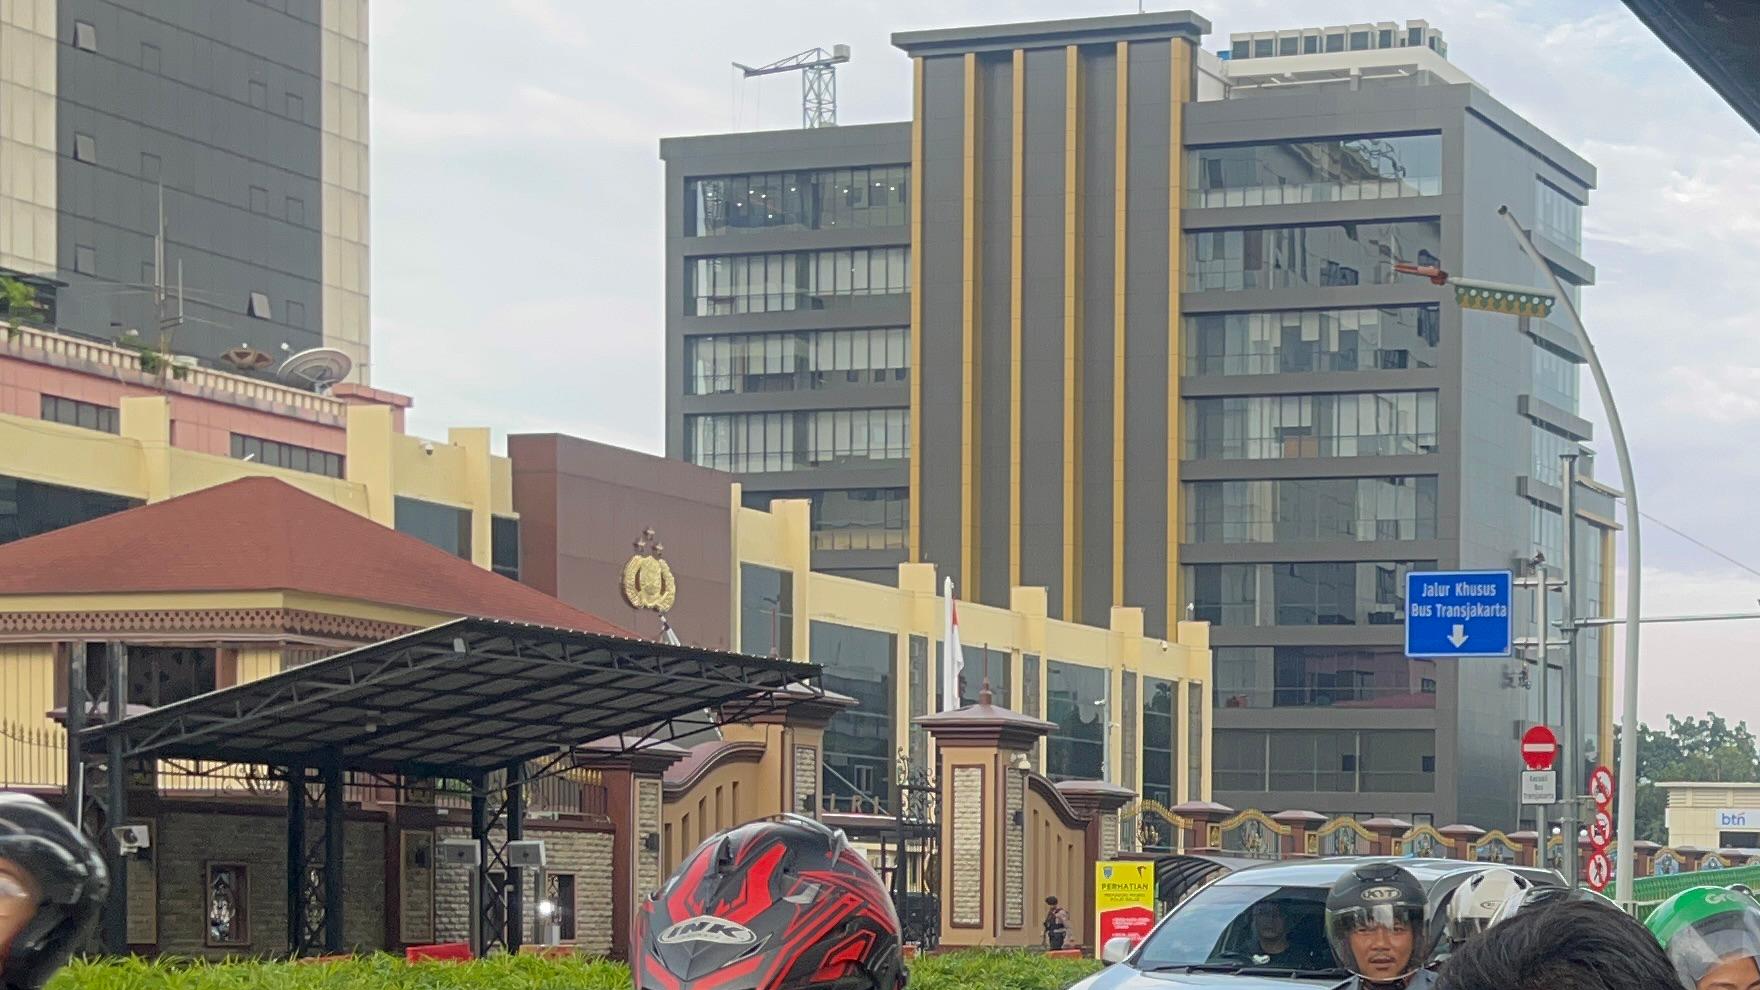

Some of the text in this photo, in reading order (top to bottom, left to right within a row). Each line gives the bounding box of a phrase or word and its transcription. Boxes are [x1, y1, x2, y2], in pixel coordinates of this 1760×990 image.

[1422, 582, 1497, 597] Jalur Khusus
[1411, 602, 1507, 621] Bus Transjakarta
[1721, 812, 1746, 826] btn
[1101, 883, 1148, 891] PERHATIAN
[668, 921, 743, 938] INK
